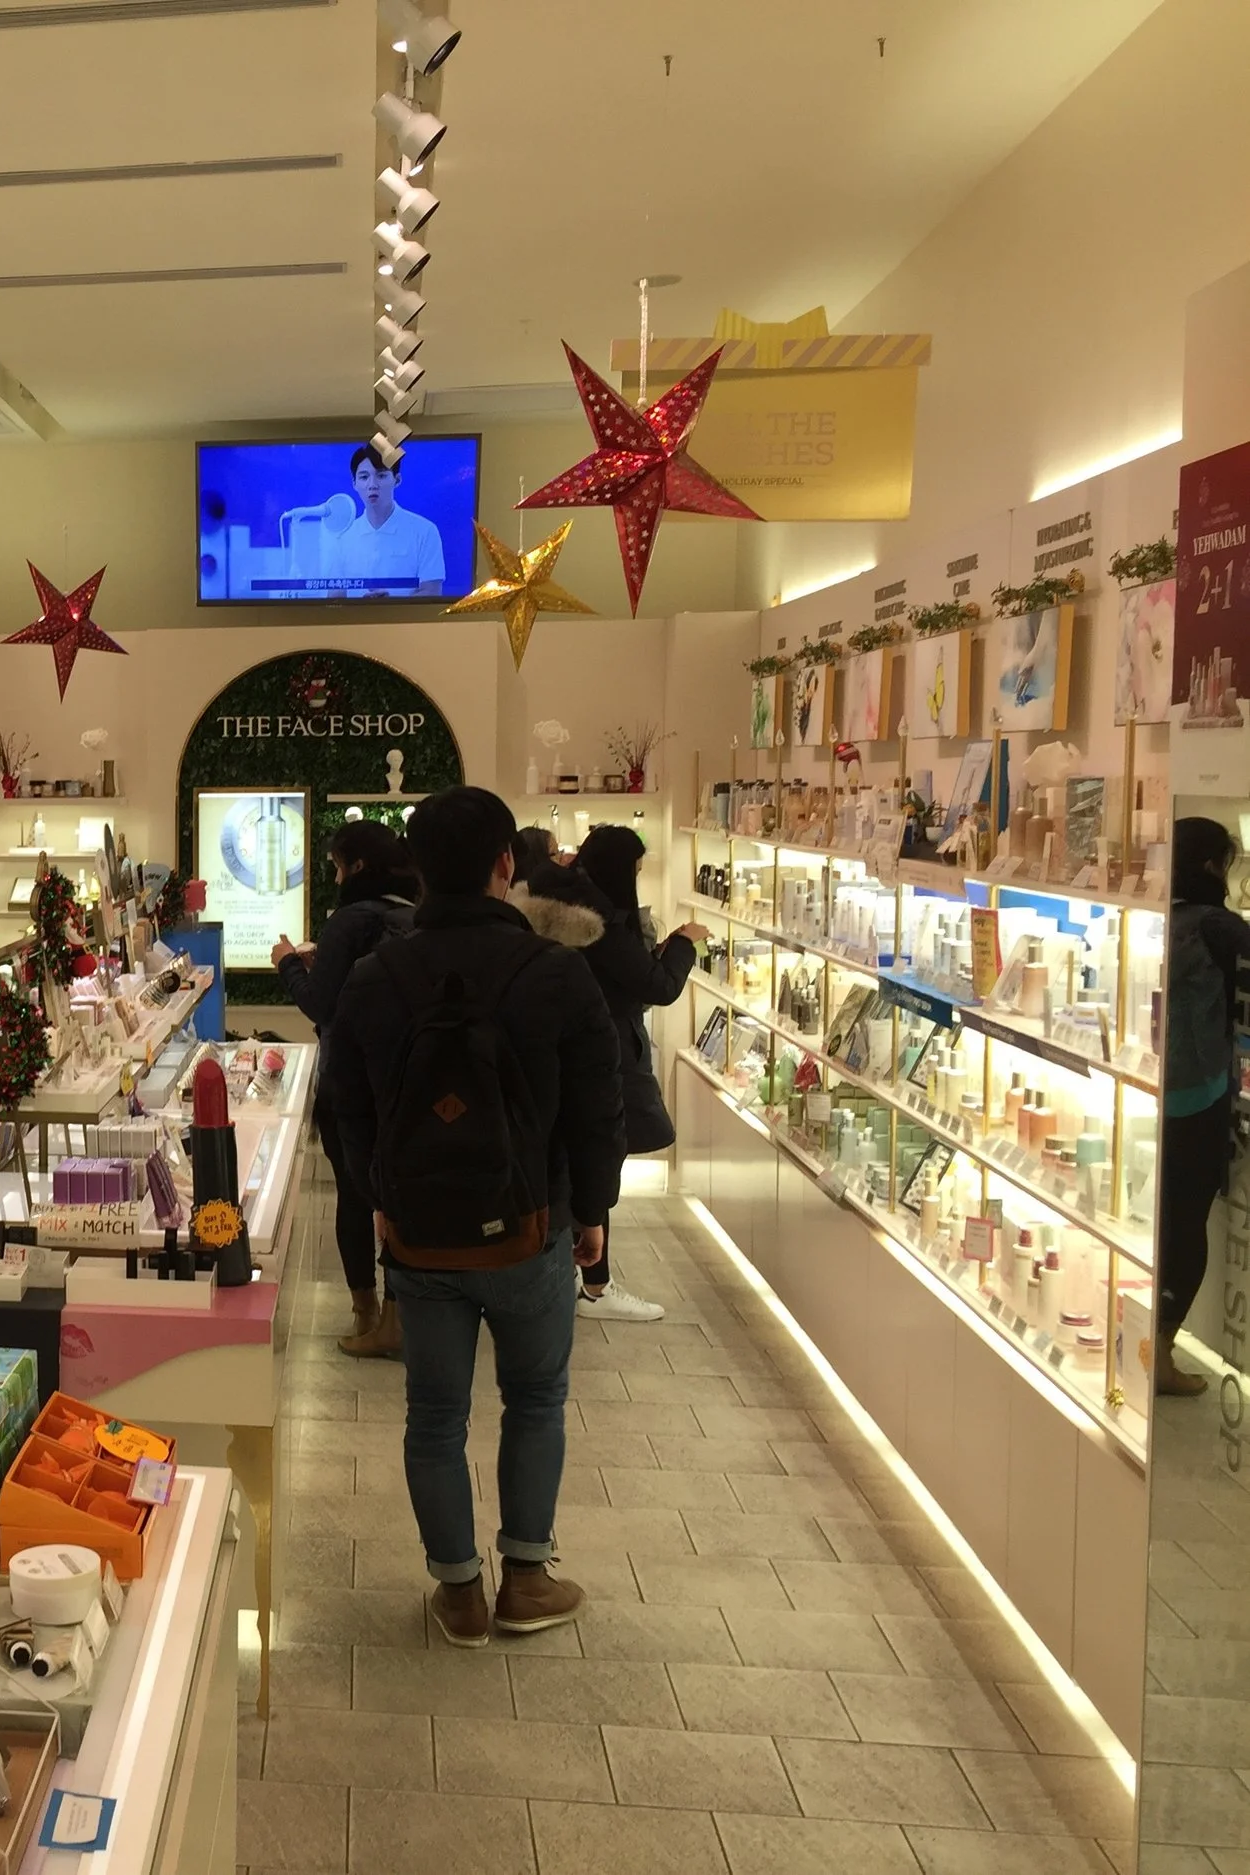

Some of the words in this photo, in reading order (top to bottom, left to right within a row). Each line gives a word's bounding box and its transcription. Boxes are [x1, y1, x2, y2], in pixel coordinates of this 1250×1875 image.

[766, 411, 836, 436] THE
[720, 477, 761, 487] HOLIDAY
[764, 477, 804, 486] SPECIAL
[1193, 524, 1247, 556] YEHWADAM
[1196, 560, 1234, 615] 2+1
[217, 715, 272, 738] THE
[276, 714, 344, 738] FACE
[349, 713, 425, 737] SHOP
[99, 1202, 139, 1217] FREE
[39, 1216, 68, 1232] MIX
[1218, 1281, 1250, 1474] SHOP
